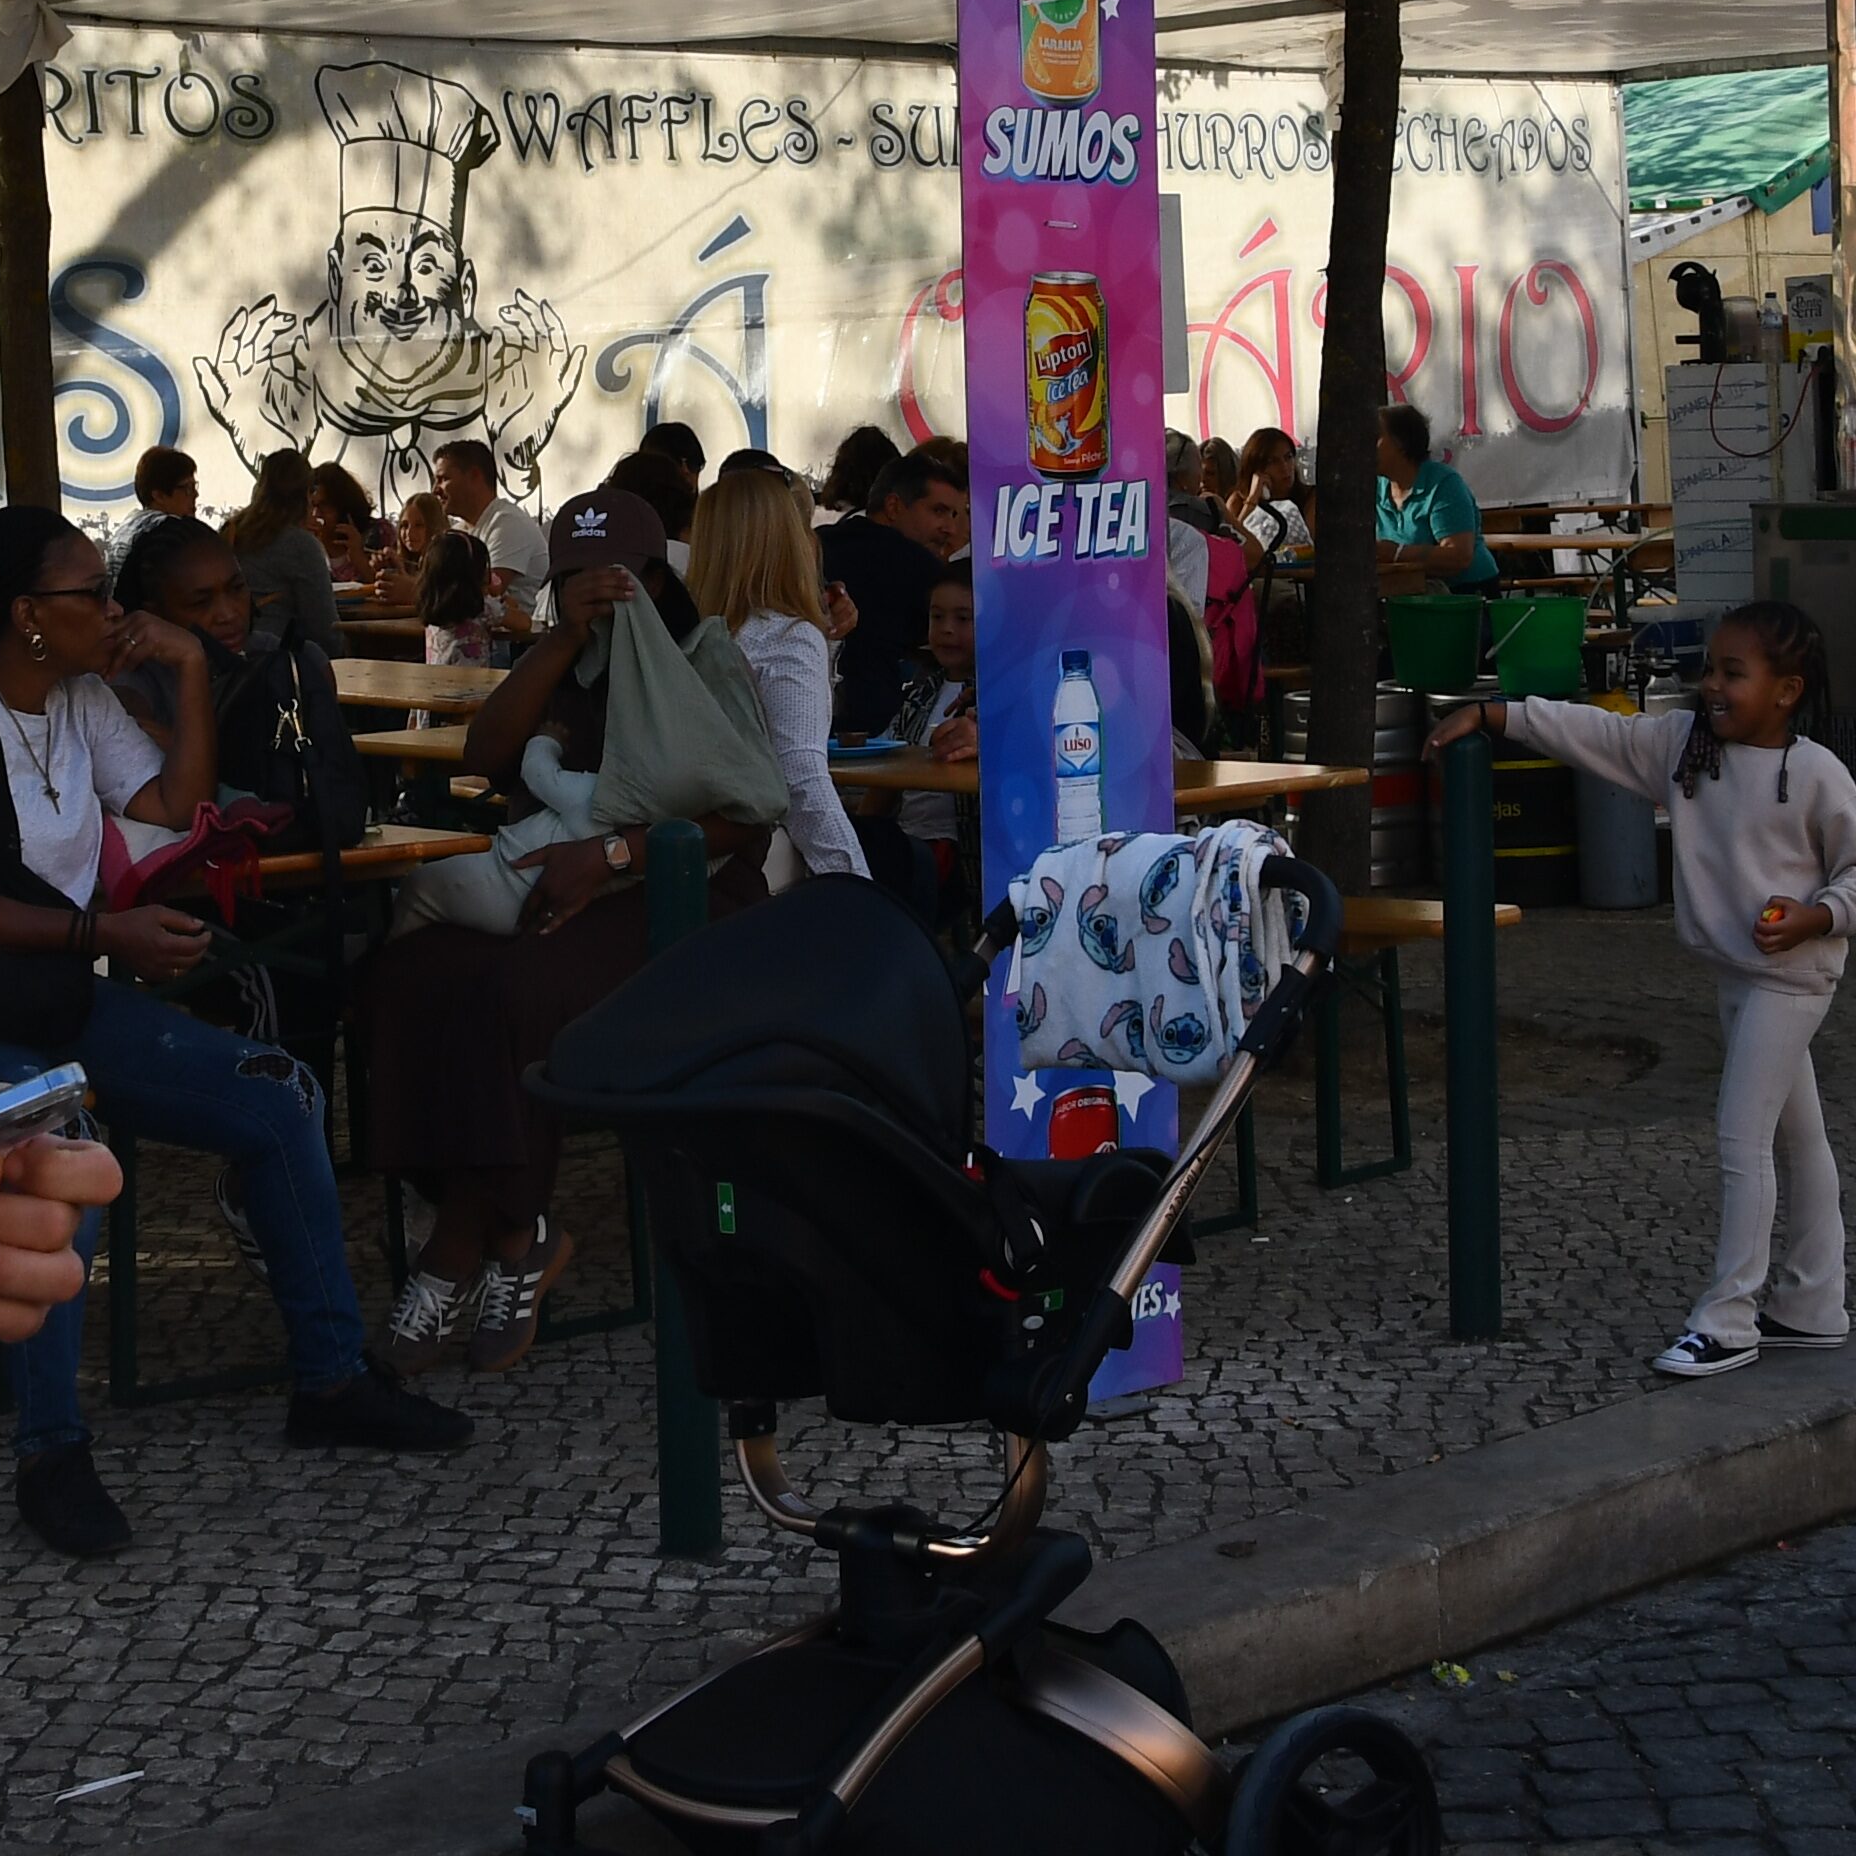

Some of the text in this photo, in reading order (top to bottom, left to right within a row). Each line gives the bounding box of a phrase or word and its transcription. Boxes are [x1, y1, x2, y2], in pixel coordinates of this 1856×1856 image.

[504, 90, 812, 171] WAFFLES
[983, 105, 1140, 182] SUMOS
[1036, 339, 1089, 373] Lipton
[571, 527, 607, 539] adidas
[992, 478, 1148, 560] ICE TEA
[1064, 737, 1092, 753] LUSO
